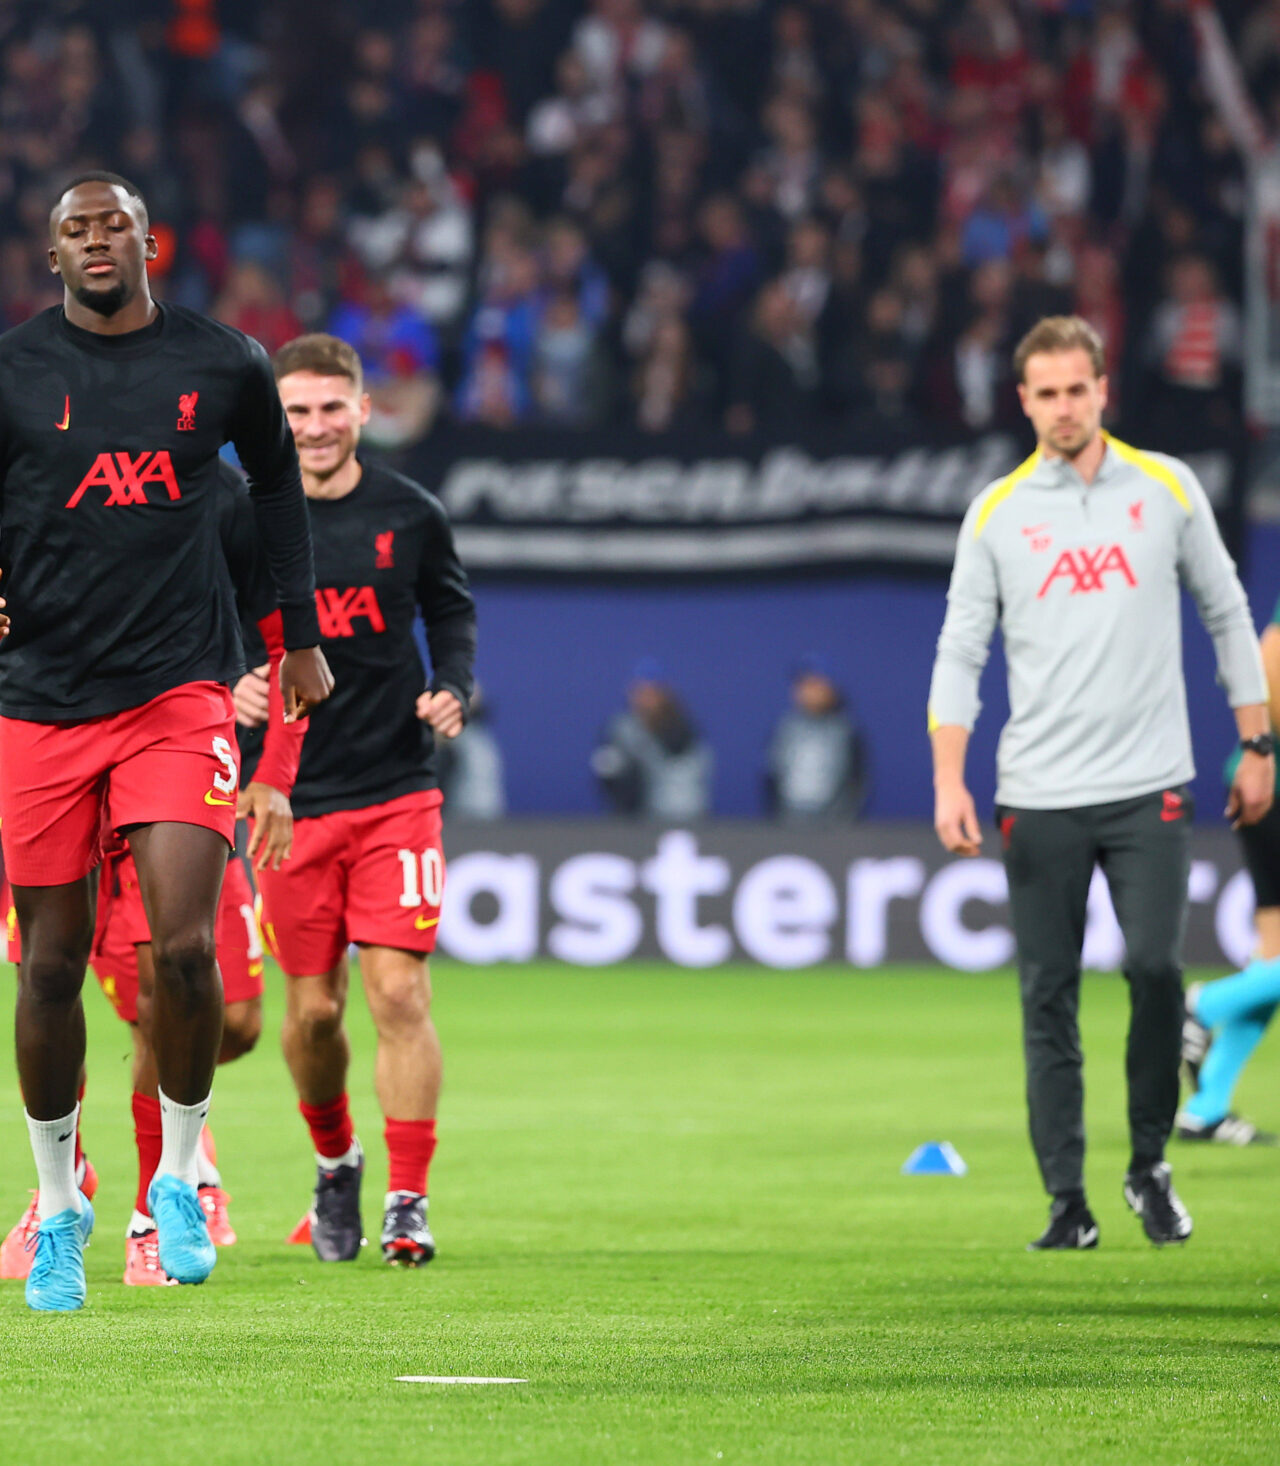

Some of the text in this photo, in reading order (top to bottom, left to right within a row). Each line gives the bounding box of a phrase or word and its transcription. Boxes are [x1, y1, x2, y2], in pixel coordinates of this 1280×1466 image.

[65, 451, 182, 508] AXA
[1036, 543, 1139, 599] AXA
[211, 736, 237, 795] 5
[398, 848, 442, 907] 10
